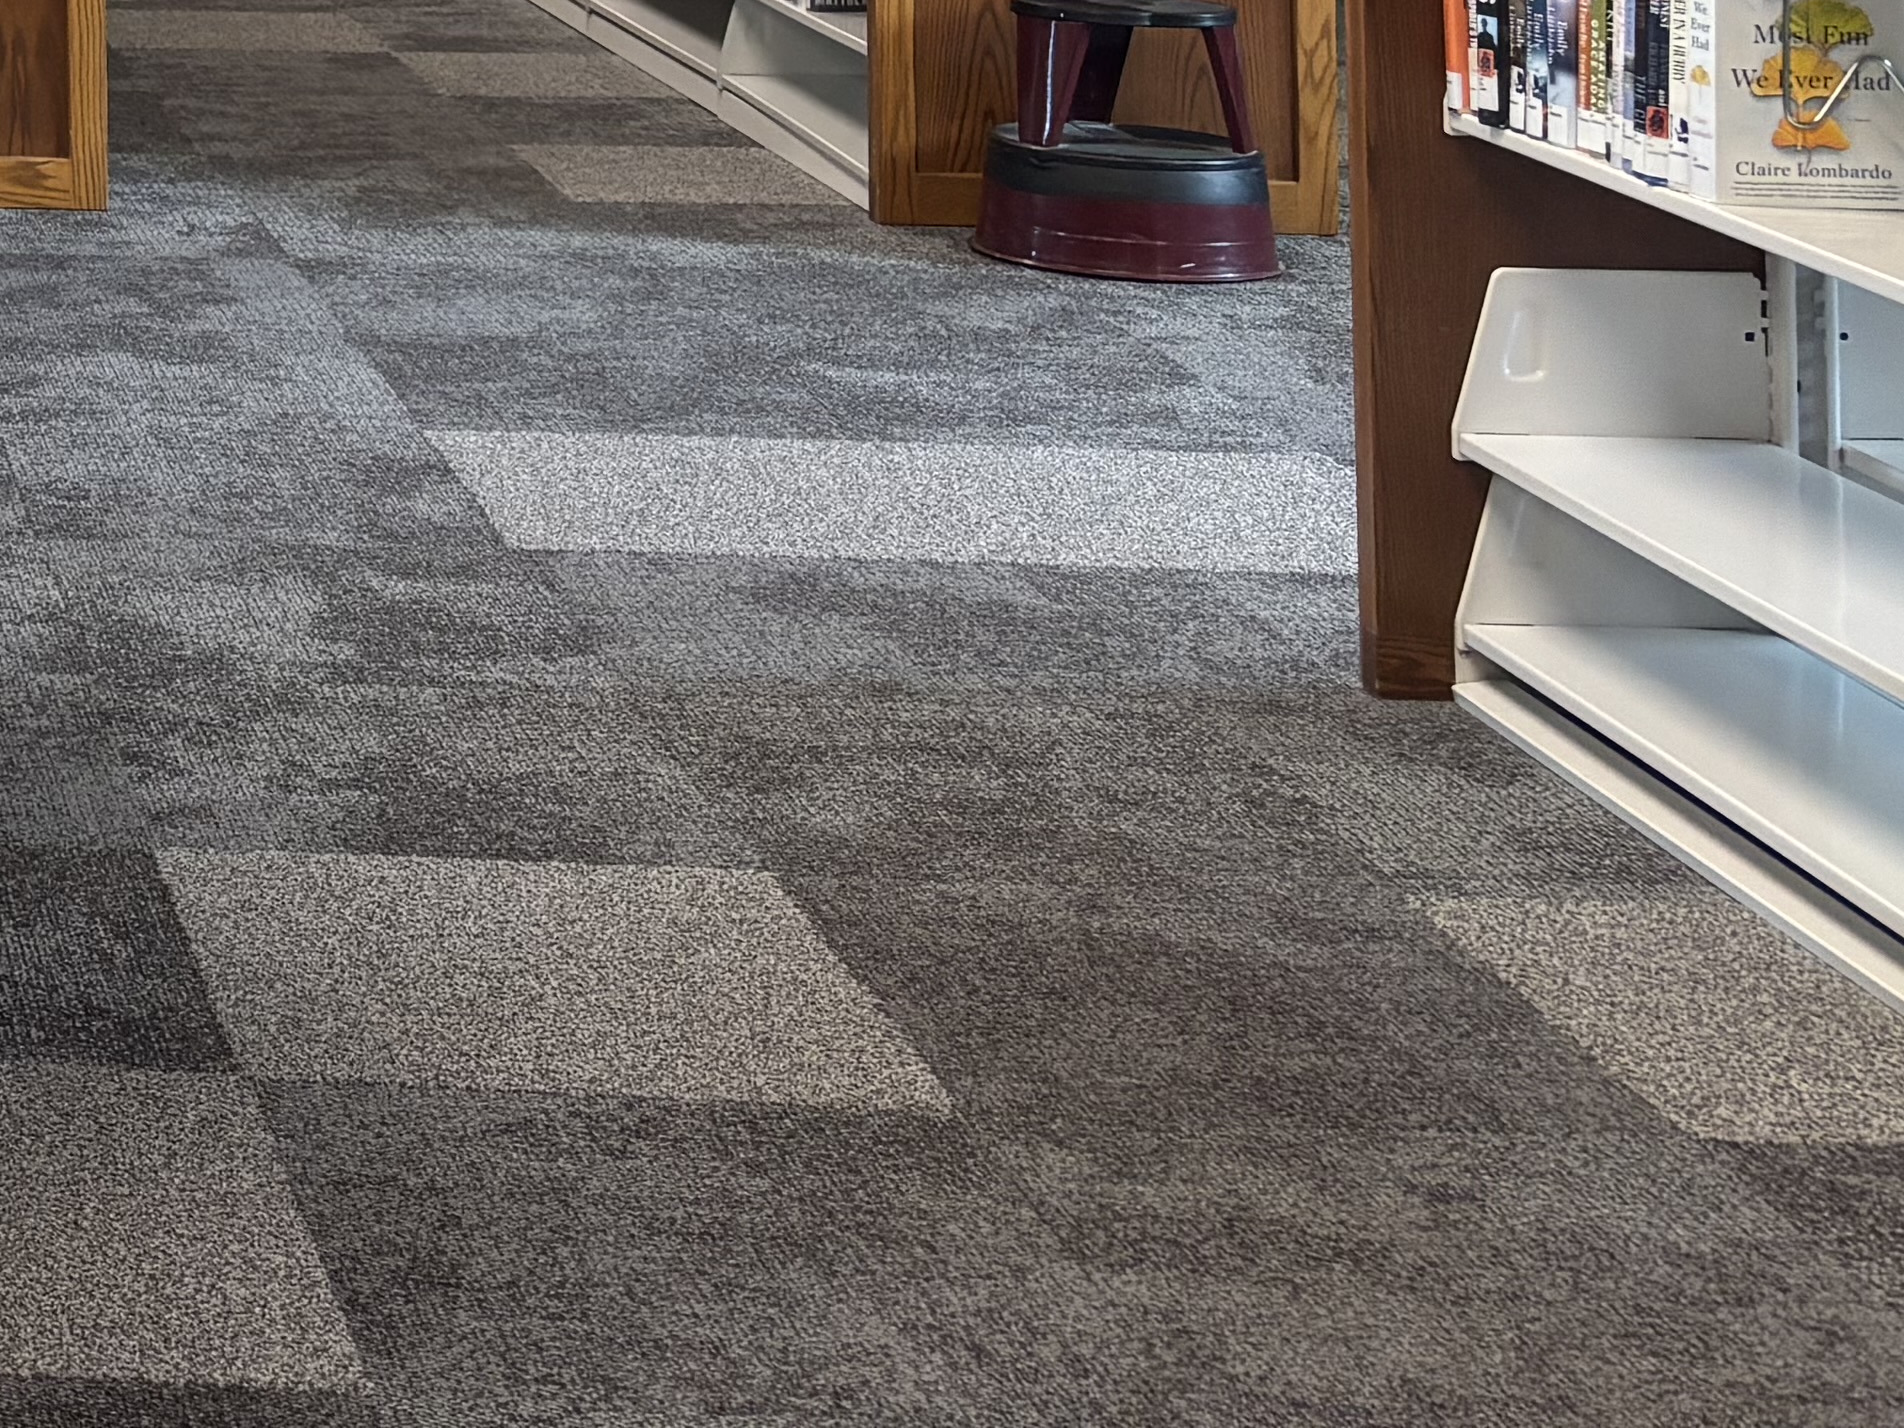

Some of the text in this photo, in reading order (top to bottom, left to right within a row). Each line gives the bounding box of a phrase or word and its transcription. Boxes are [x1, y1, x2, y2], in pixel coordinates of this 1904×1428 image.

[1693, 0, 1709, 15] We
[1533, 12, 1545, 50] Emily
[1691, 17, 1711, 34] Ever
[1823, 24, 1870, 46] Fun
[1556, 20, 1569, 56] Emily
[1591, 19, 1599, 71] GRACE
[1692, 34, 1709, 51] Had
[1673, 42, 1687, 84] HURRY
[1731, 68, 1769, 89] We
[1735, 160, 1893, 180] Claire Lombardo
